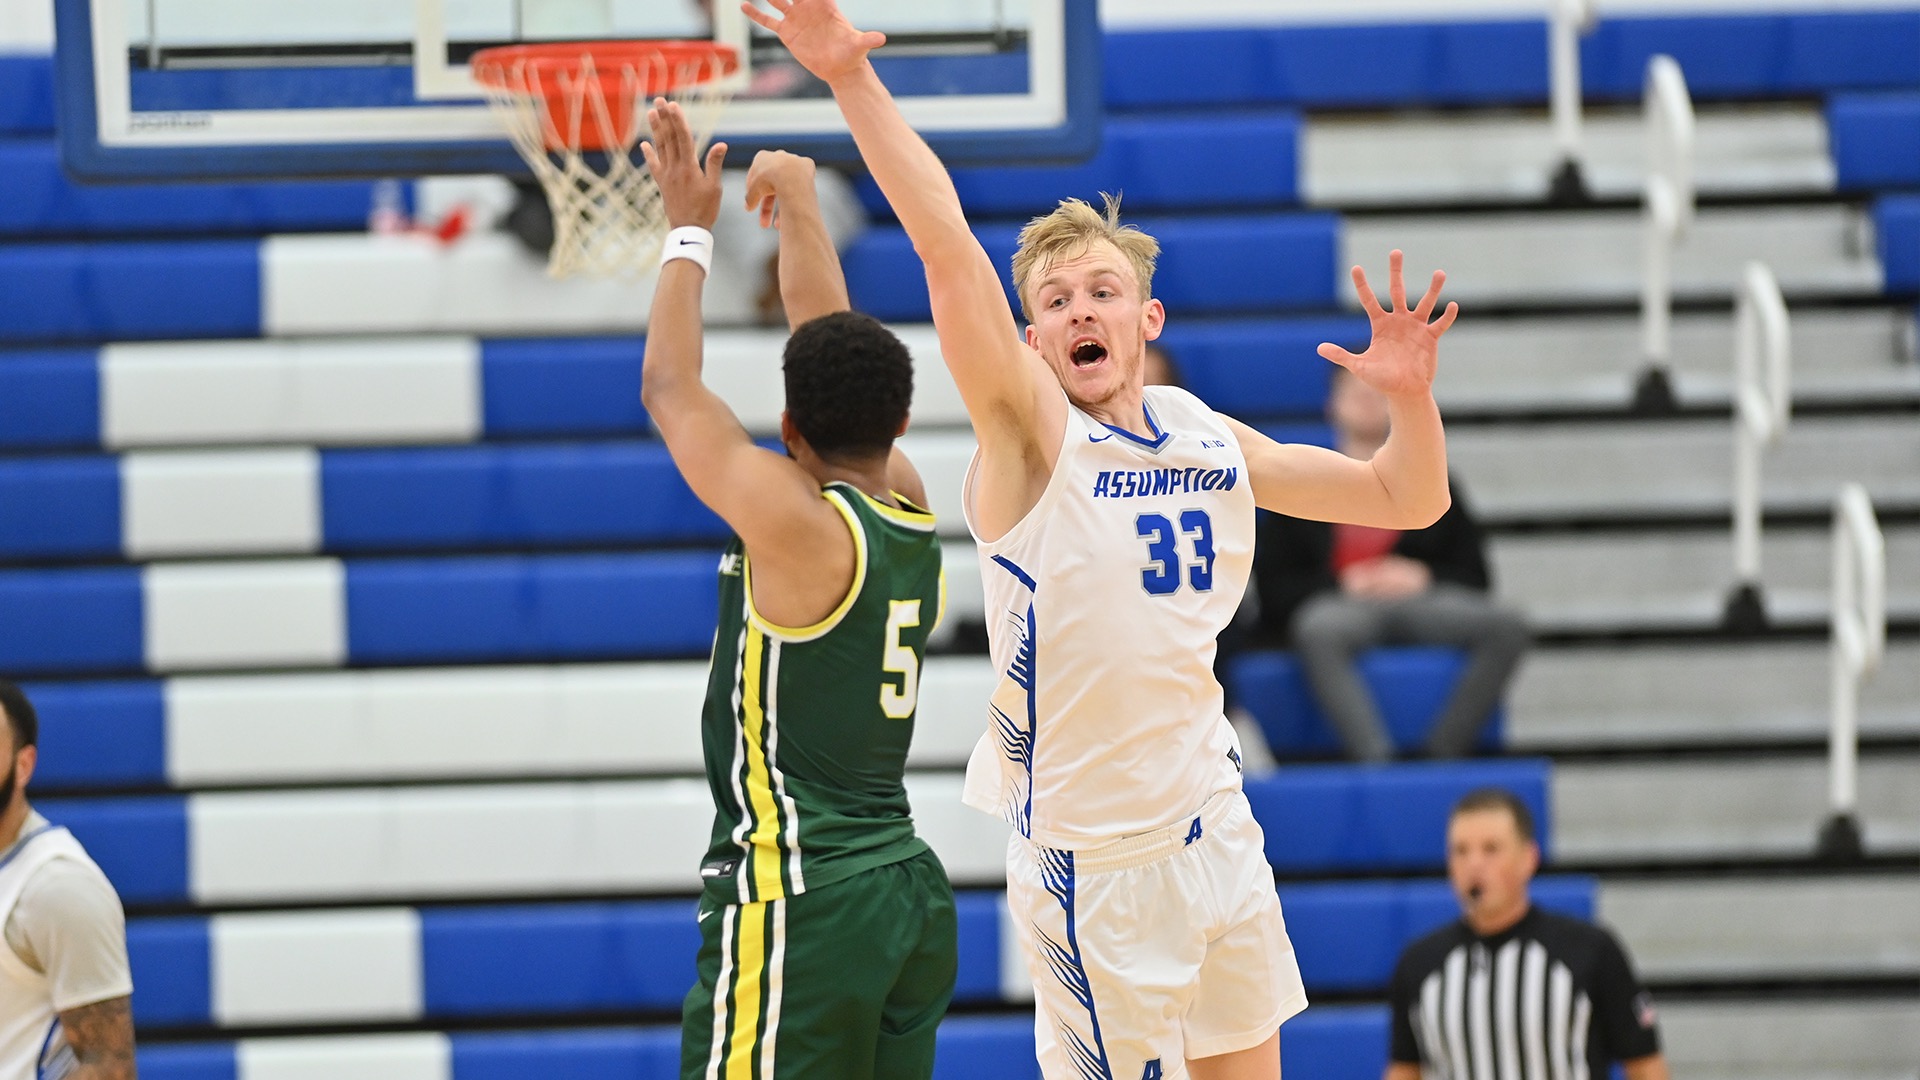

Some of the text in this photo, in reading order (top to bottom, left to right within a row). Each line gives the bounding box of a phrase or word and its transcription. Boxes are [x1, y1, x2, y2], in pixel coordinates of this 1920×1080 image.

[1093, 467, 1237, 498] ASSUMPTION
[1133, 507, 1216, 597] 33
[879, 598, 922, 719] 5
[1184, 816, 1203, 846] A
